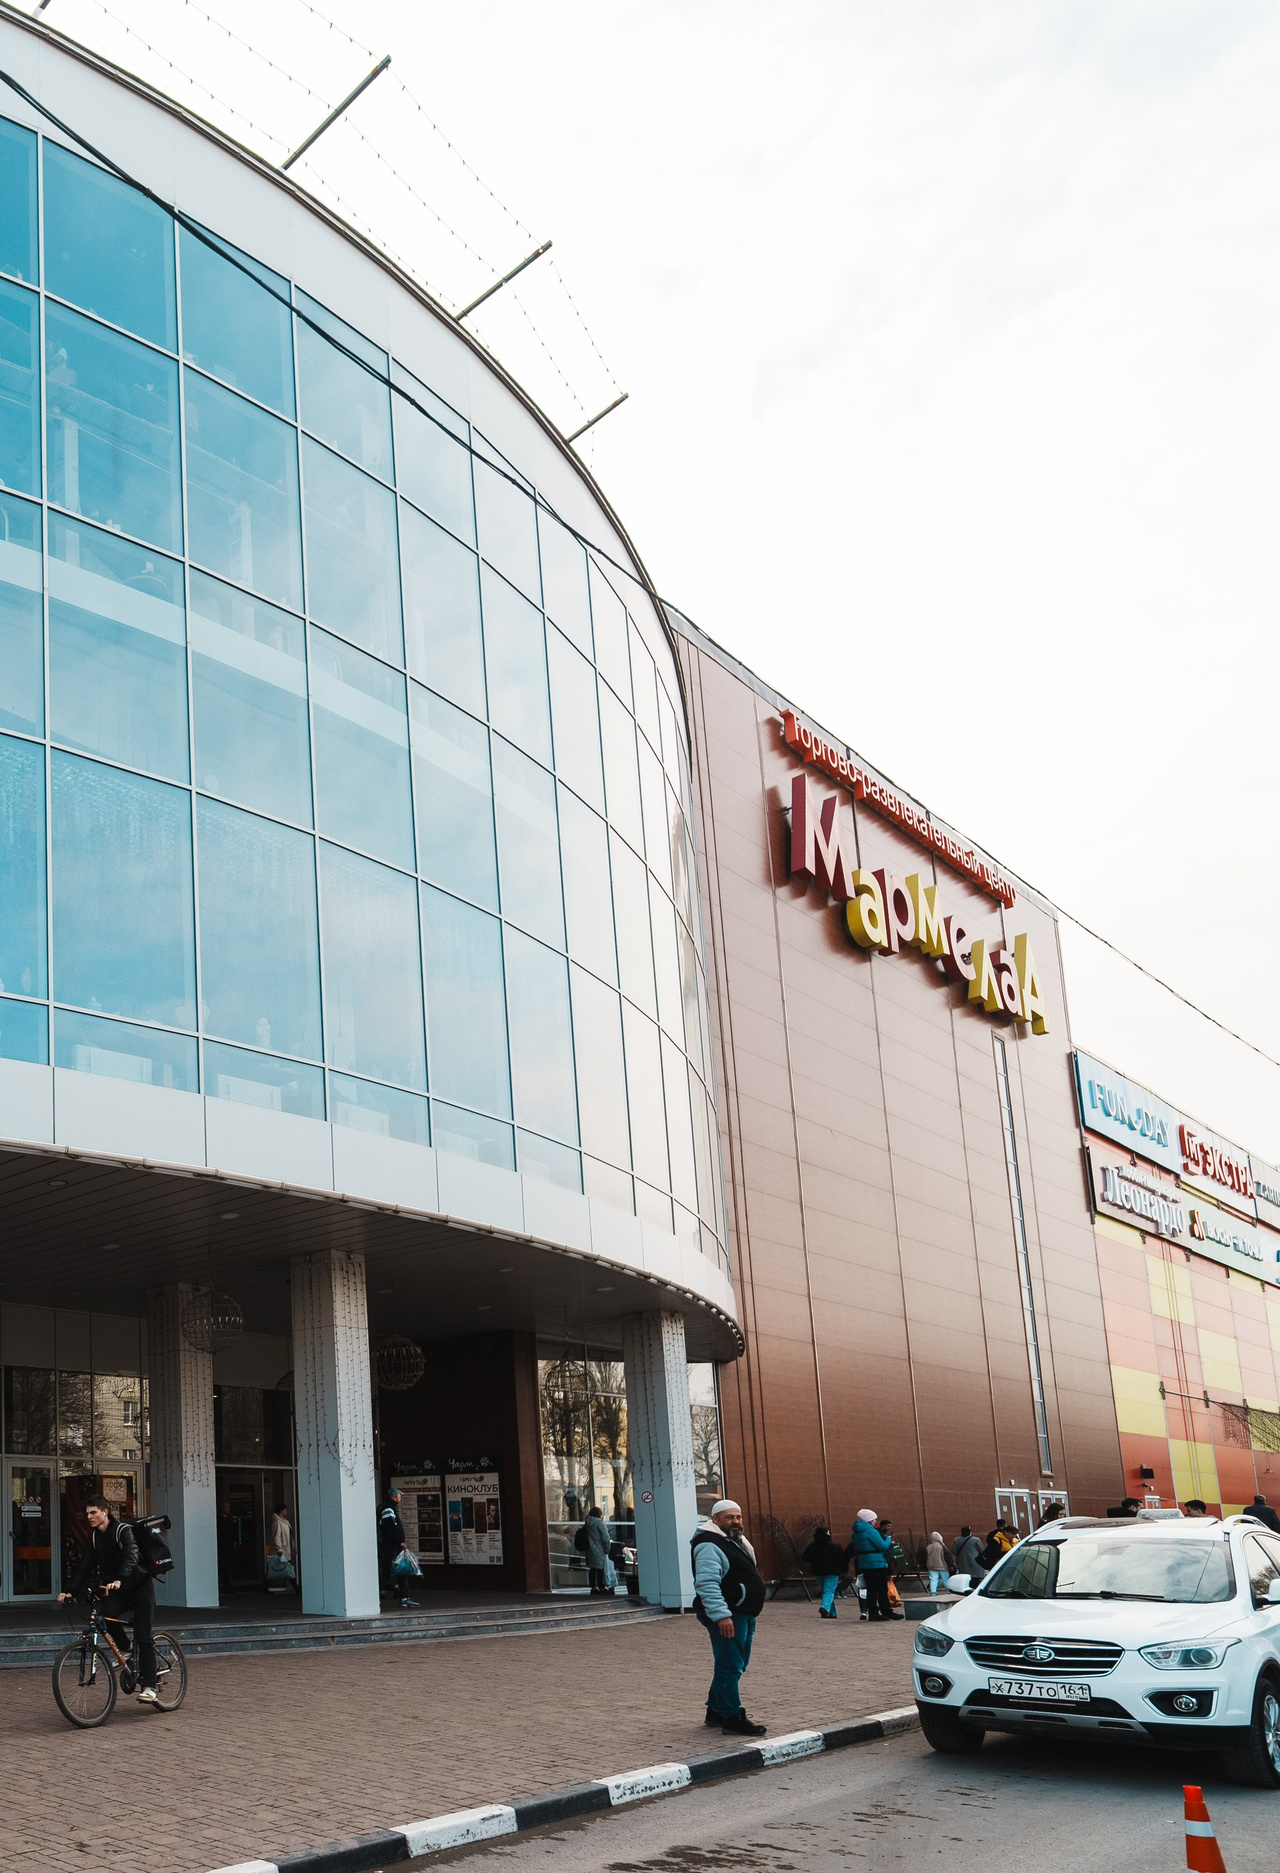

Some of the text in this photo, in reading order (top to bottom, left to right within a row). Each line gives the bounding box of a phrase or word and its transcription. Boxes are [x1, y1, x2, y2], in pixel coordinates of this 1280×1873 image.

[779, 708, 1018, 909] Торгово-развлекательный центр
[1088, 1079, 1170, 1148] FUN DAY
[1102, 1166, 1186, 1237] Леонардо
[1203, 1145, 1255, 1199] ЭКСТРА
[447, 1483, 499, 1494] КИНОКЛУБ
[1060, 1685, 1084, 1696] 161
